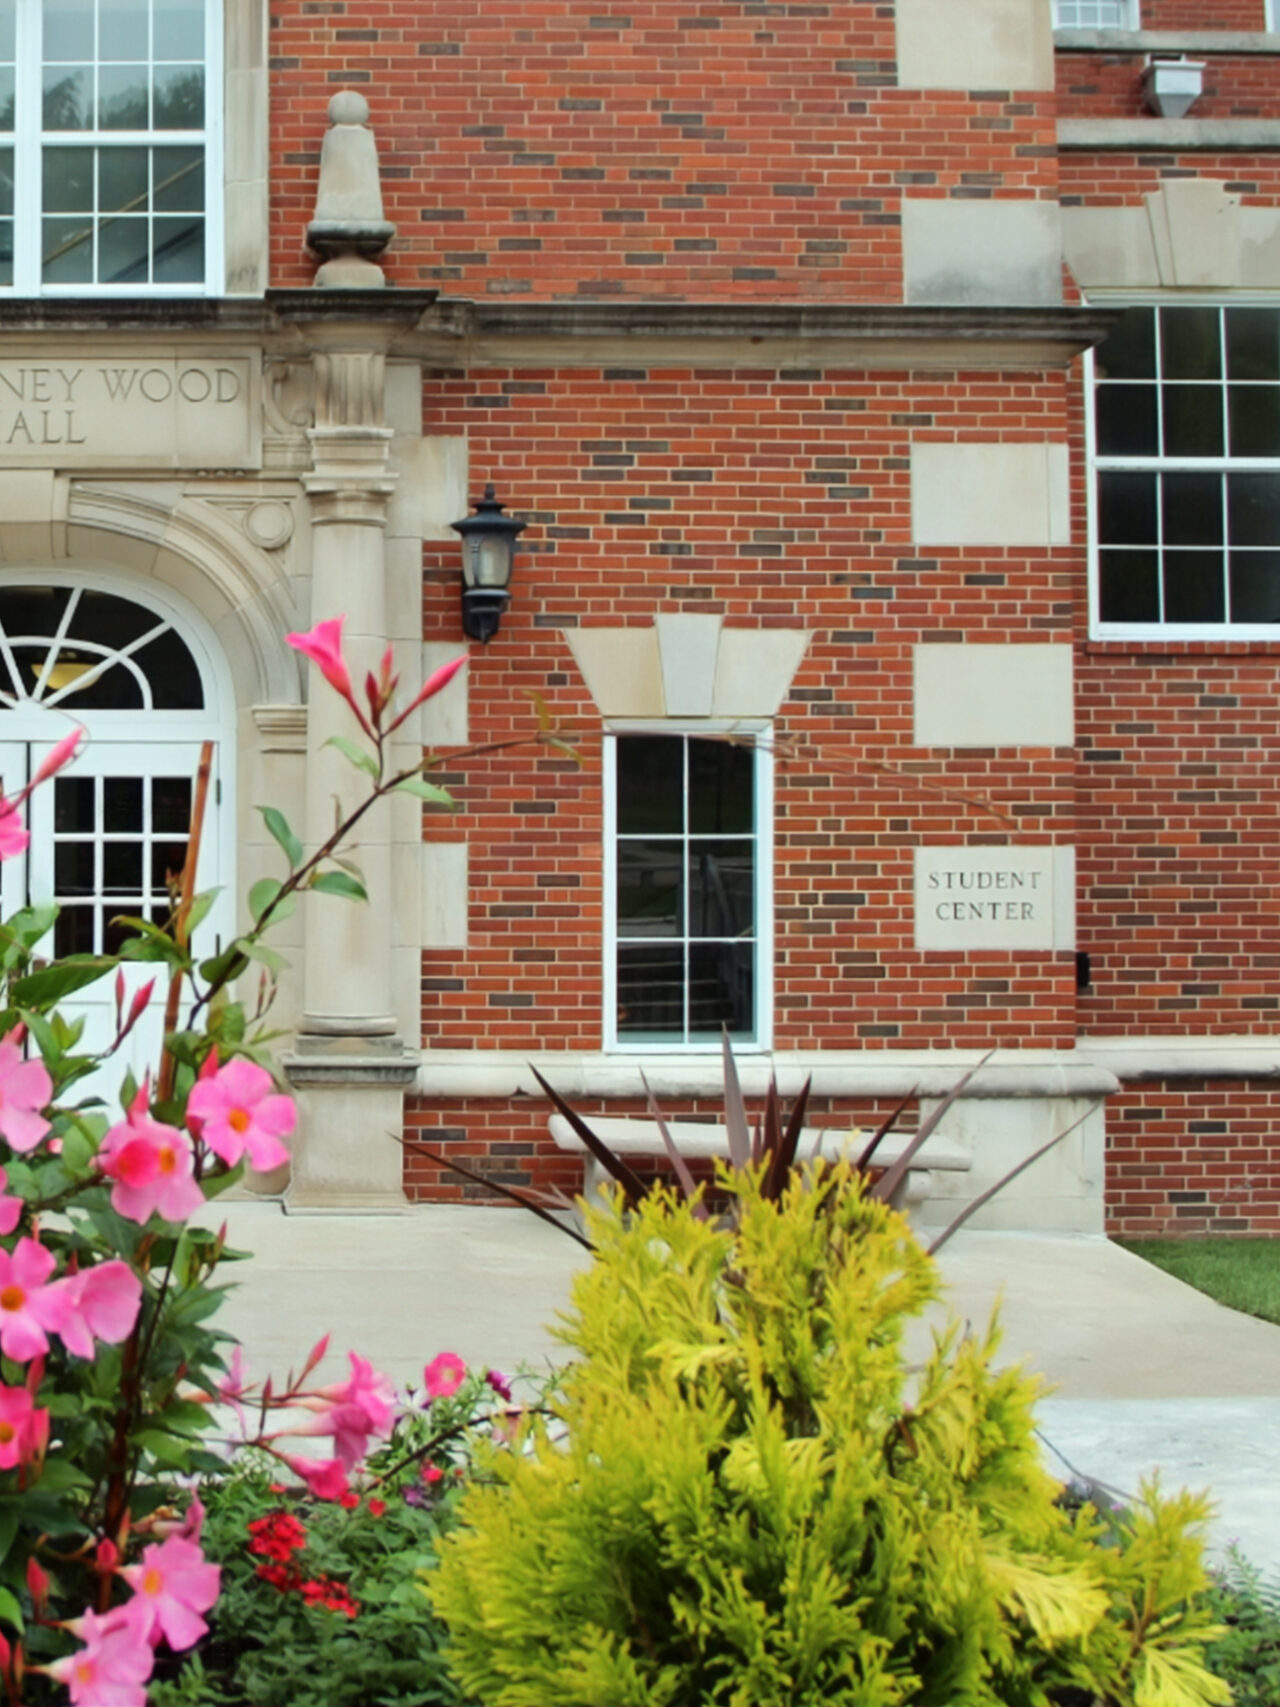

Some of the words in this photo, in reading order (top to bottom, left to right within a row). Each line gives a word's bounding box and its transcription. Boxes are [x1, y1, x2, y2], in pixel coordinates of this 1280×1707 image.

[97, 368, 242, 403] WOOD
[927, 871, 1042, 890] STUDENT
[935, 902, 1035, 921] CENTER
